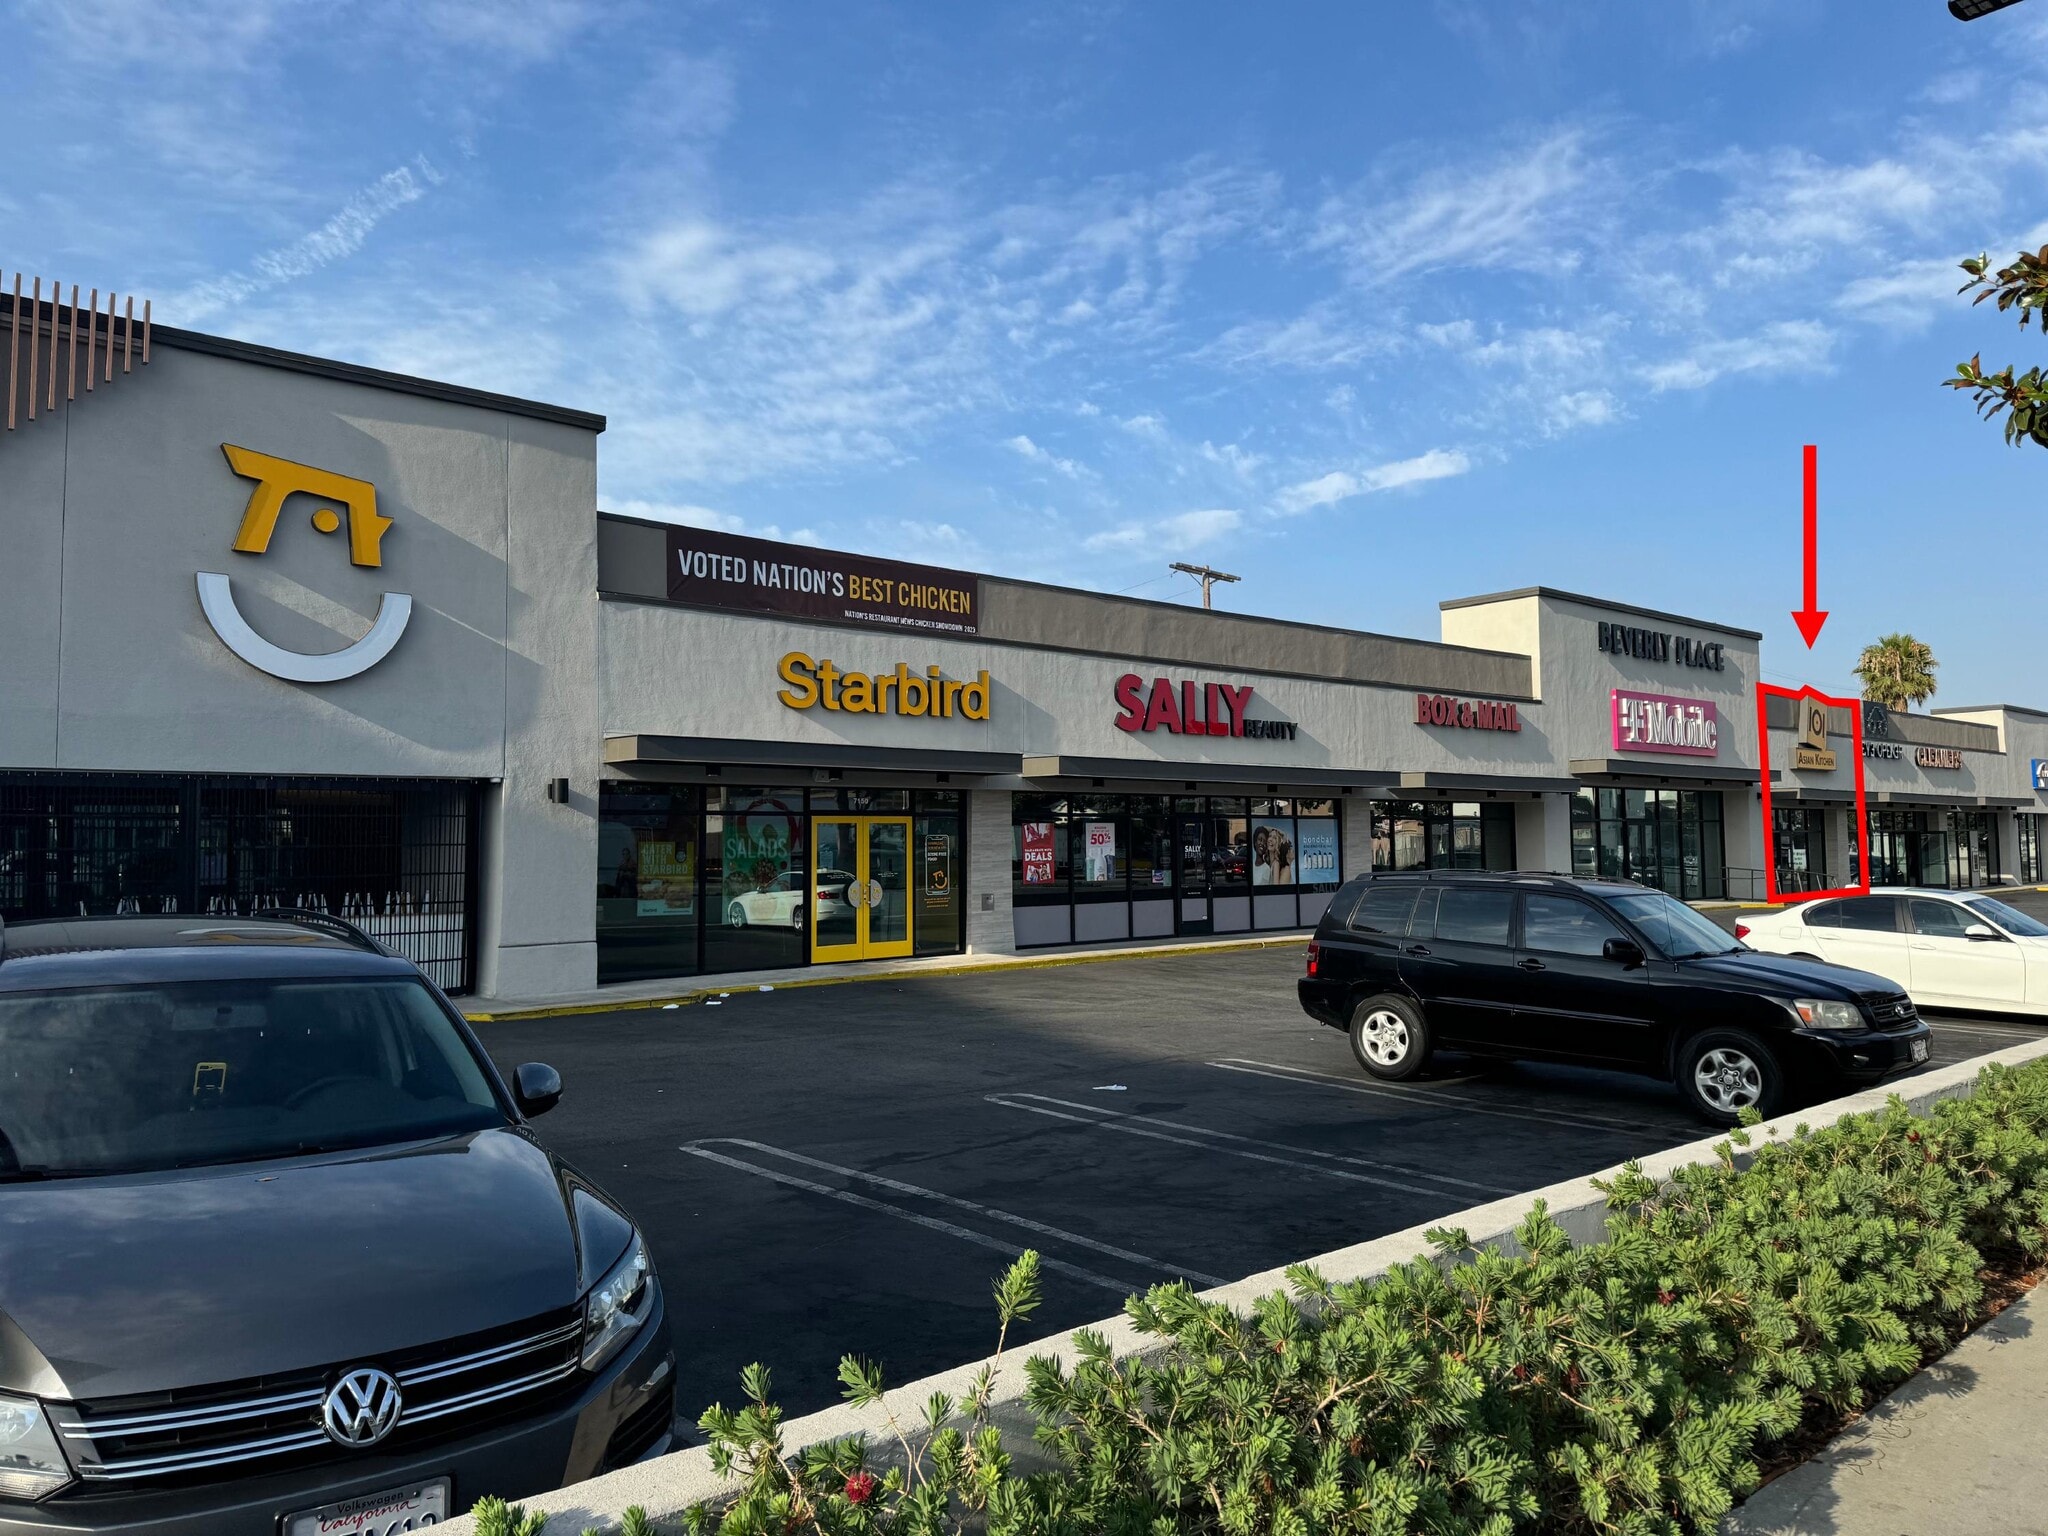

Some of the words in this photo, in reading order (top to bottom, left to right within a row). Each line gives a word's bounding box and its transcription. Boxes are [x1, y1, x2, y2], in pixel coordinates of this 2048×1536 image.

[678, 549, 747, 583] VOTED
[753, 560, 844, 597] NATION'S
[849, 574, 893, 604] BEST
[899, 582, 971, 614] CHICKEN
[844, 610, 868, 620] NATION'S
[868, 613, 900, 624] RESTAURANT
[900, 617, 915, 626] NEWS
[915, 619, 935, 628] CHICKEN
[935, 621, 963, 632] SHOWDOWN
[964, 625, 976, 633] 2023
[1598, 621, 1672, 662] BEVERLY
[1676, 636, 1725, 672] PLACE
[777, 651, 990, 721] Starbird
[1114, 673, 1254, 738] SALLY
[1416, 694, 1458, 727] BOX
[1460, 704, 1477, 729] &
[1478, 702, 1522, 732] MAIL
[1244, 719, 1298, 741] BEAUTY
[726, 838, 789, 860] SALADS
[1024, 851, 1053, 862] DEALS
[1184, 845, 1202, 853] SALLY
[643, 864, 688, 875] STARBIRD
[336, 1491, 404, 1514] Volkswagen
[321, 1500, 420, 1533] California
